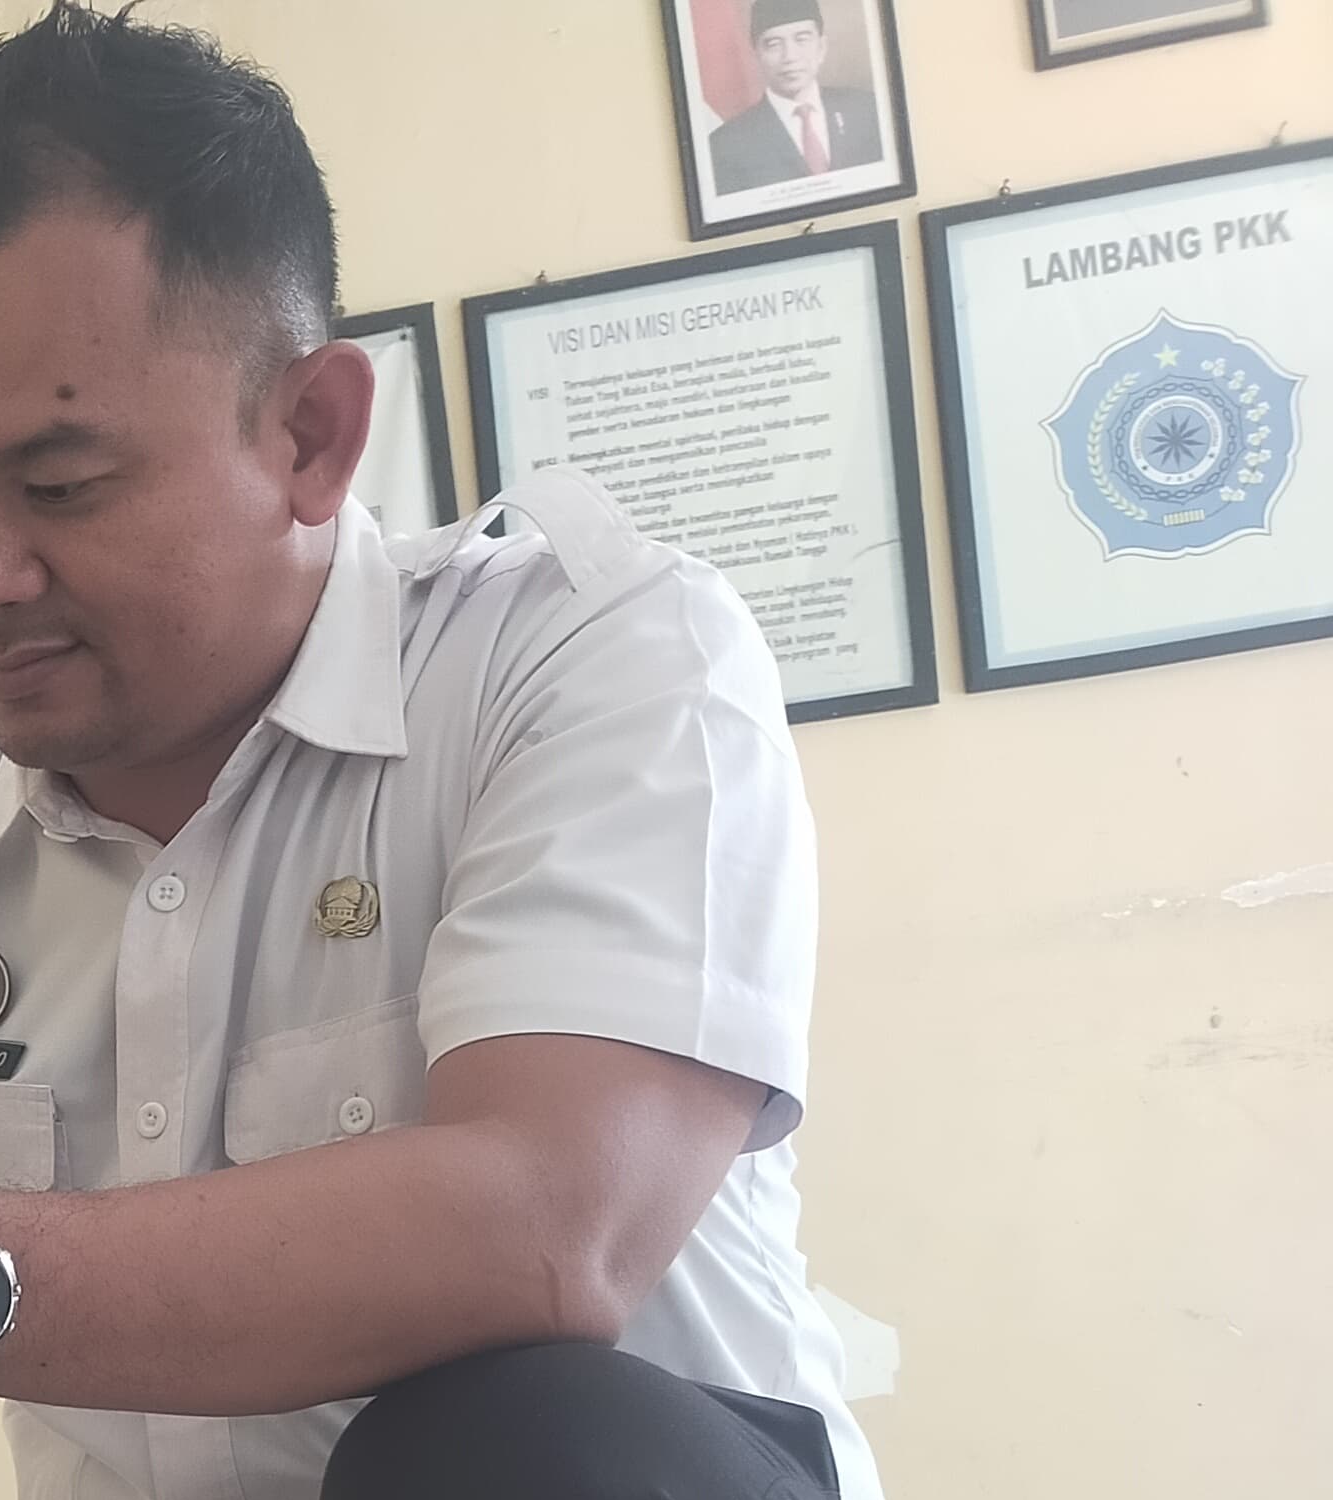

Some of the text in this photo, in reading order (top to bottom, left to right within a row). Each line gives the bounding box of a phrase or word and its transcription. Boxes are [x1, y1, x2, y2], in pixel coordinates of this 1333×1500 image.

[1022, 209, 1293, 289] LAMBANG PKK
[547, 286, 823, 354] VISI DAN MISI GERAKAN PKK
